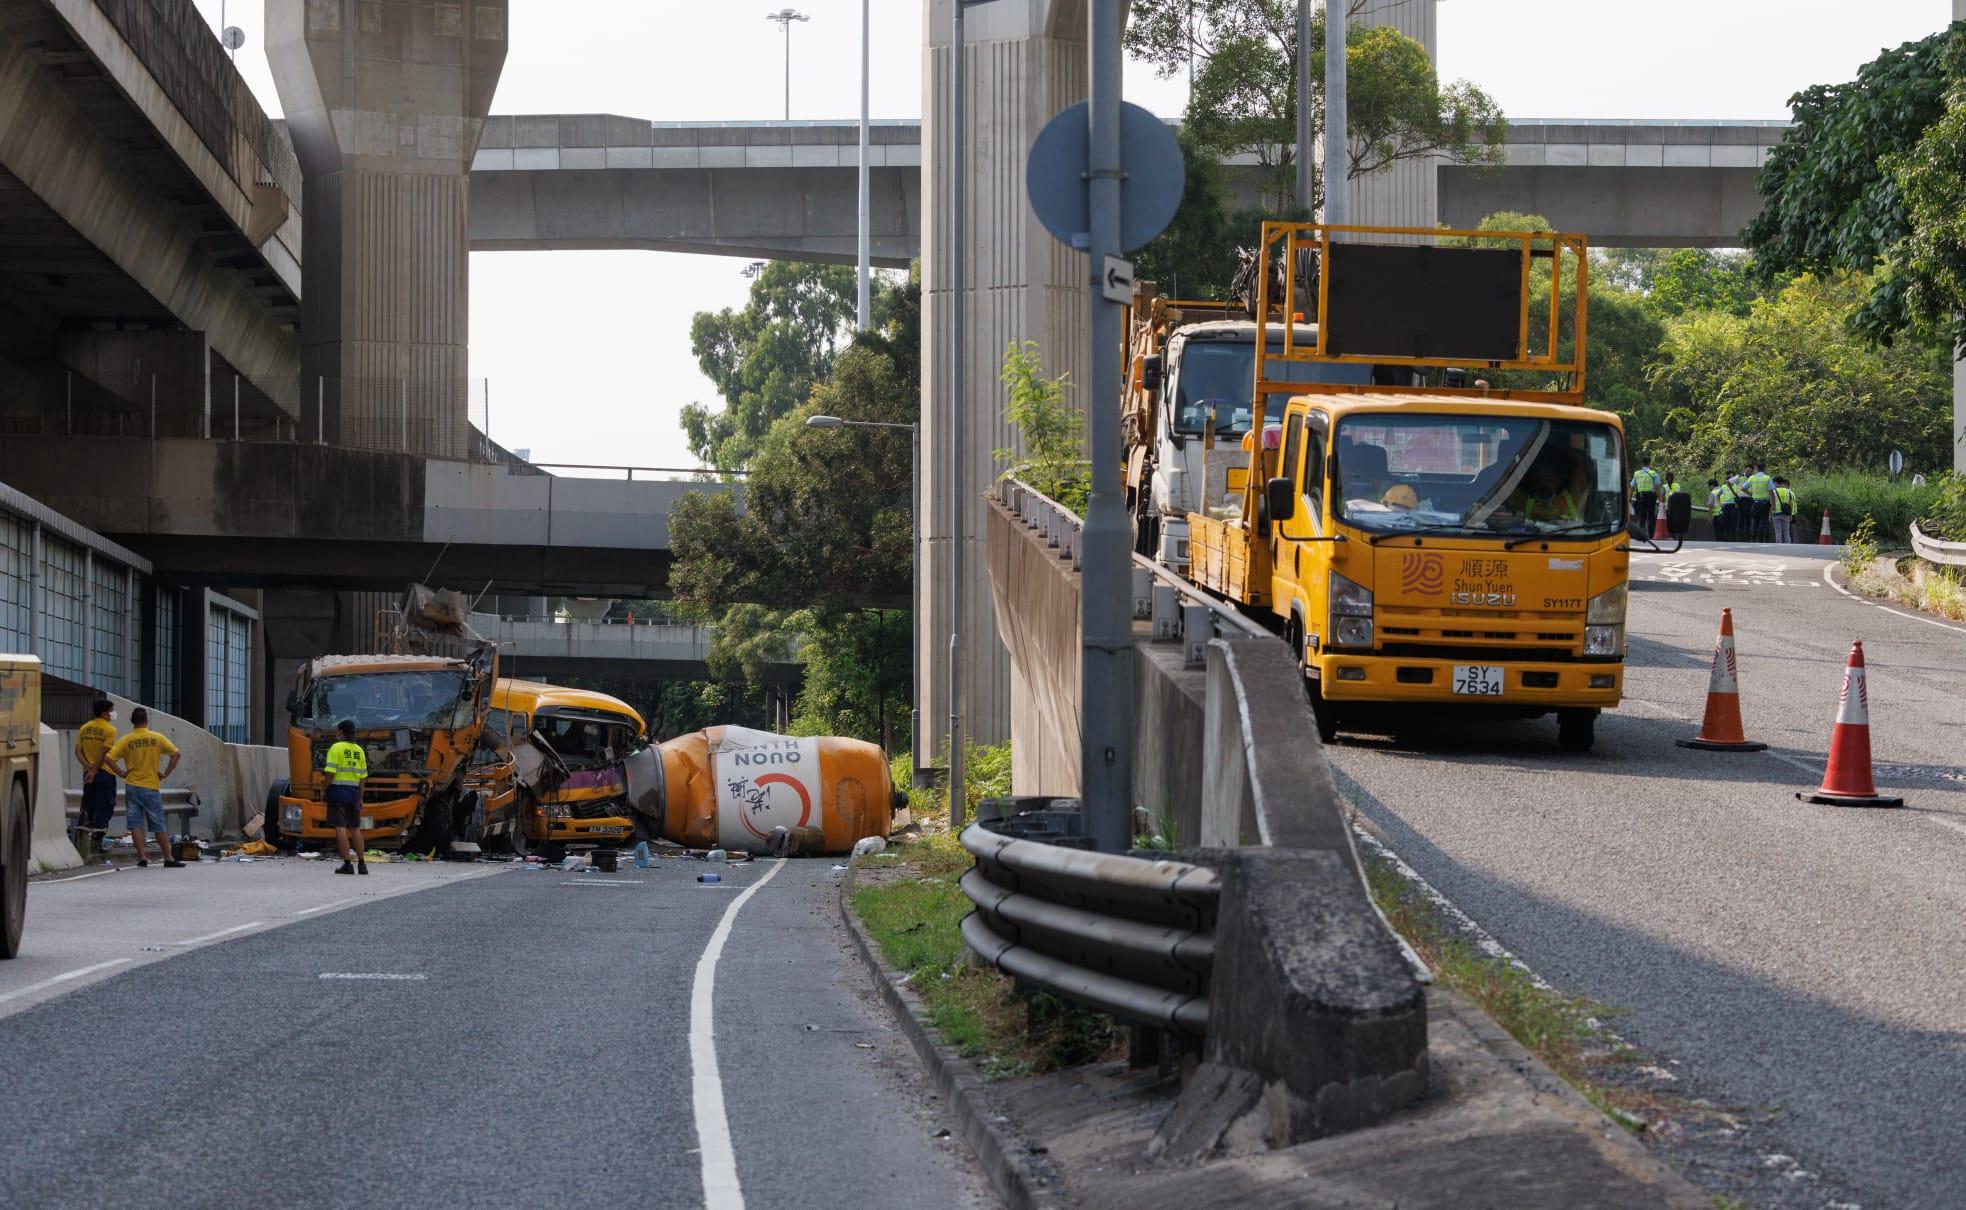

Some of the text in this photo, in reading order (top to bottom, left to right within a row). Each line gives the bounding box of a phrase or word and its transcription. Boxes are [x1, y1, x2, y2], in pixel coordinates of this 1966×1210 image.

[1460, 558, 1508, 578] 順源
[1454, 578, 1513, 593] Shun Yuen
[1450, 592, 1516, 606] ISUZU
[1543, 598, 1582, 609] SY117T
[1468, 666, 1489, 680] SY
[1456, 680, 1500, 695] 7634
[735, 751, 802, 766] QUON
